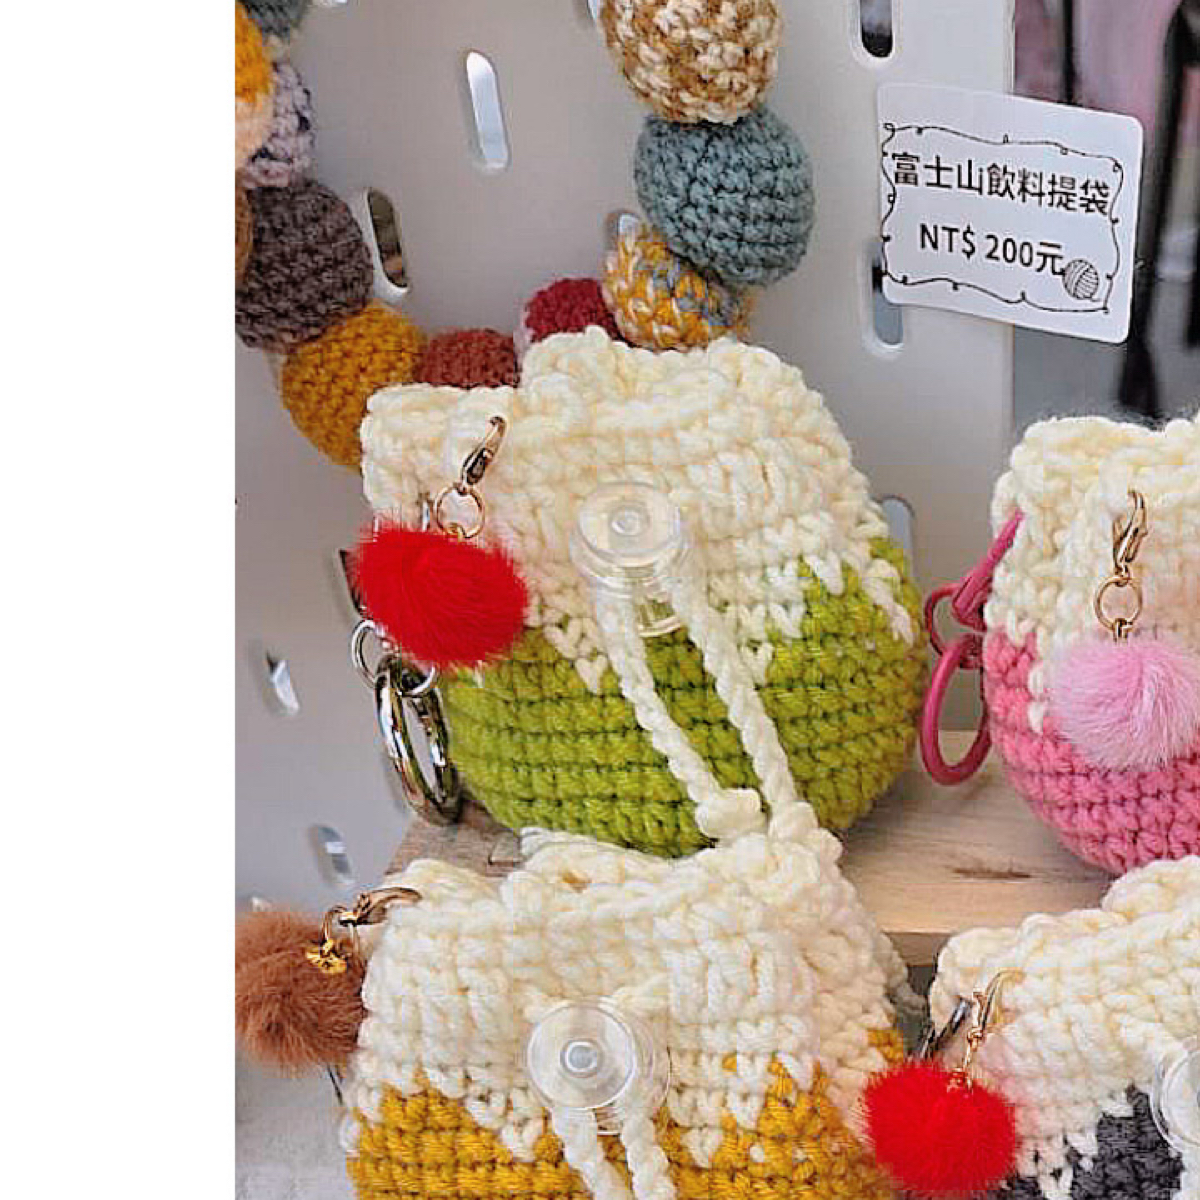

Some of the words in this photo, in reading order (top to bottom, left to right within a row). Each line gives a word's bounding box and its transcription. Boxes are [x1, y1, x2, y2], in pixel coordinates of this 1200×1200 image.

[892, 152, 1109, 215] 富士山飲料提袋
[919, 222, 977, 260] NT$
[984, 233, 1065, 278] 200元
